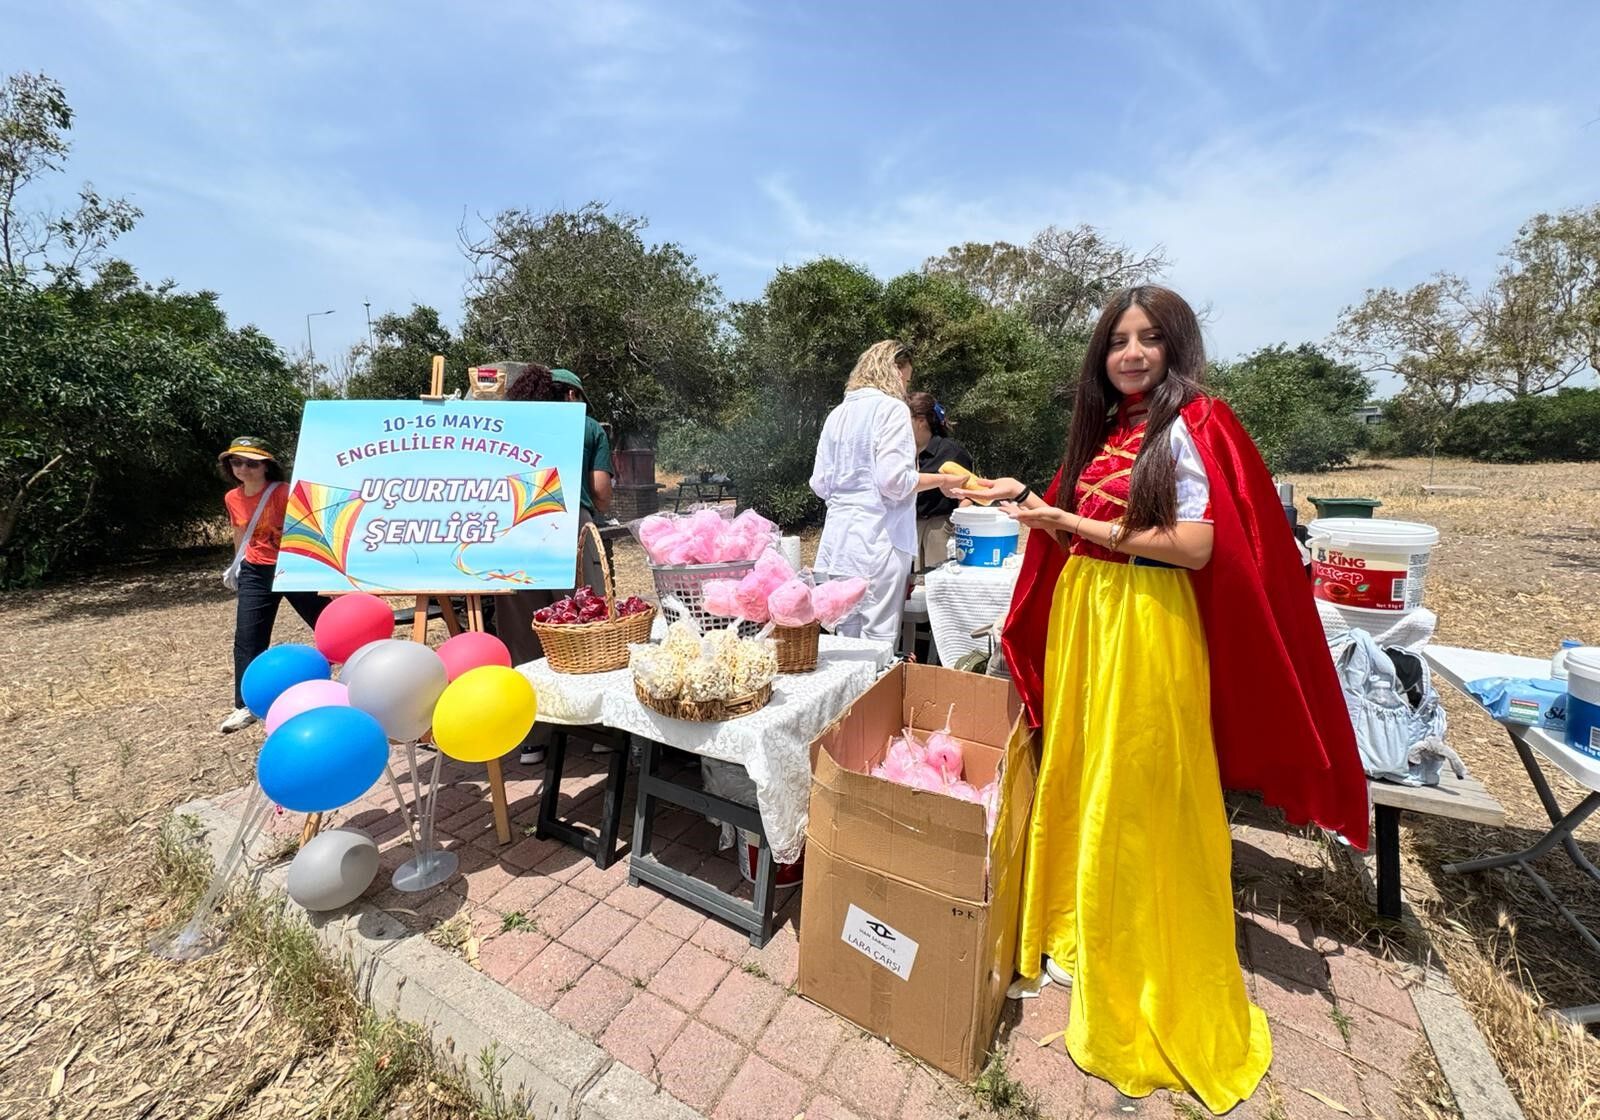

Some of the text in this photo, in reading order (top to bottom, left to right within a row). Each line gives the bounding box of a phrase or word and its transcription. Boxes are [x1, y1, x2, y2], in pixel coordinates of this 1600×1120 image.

[383, 414, 504, 433] 10-16 MAYIS
[336, 433, 542, 468] ENGELLİLER HATFASI
[361, 477, 511, 509] UÇURTMA
[364, 511, 499, 551] ŞENLİĞİ
